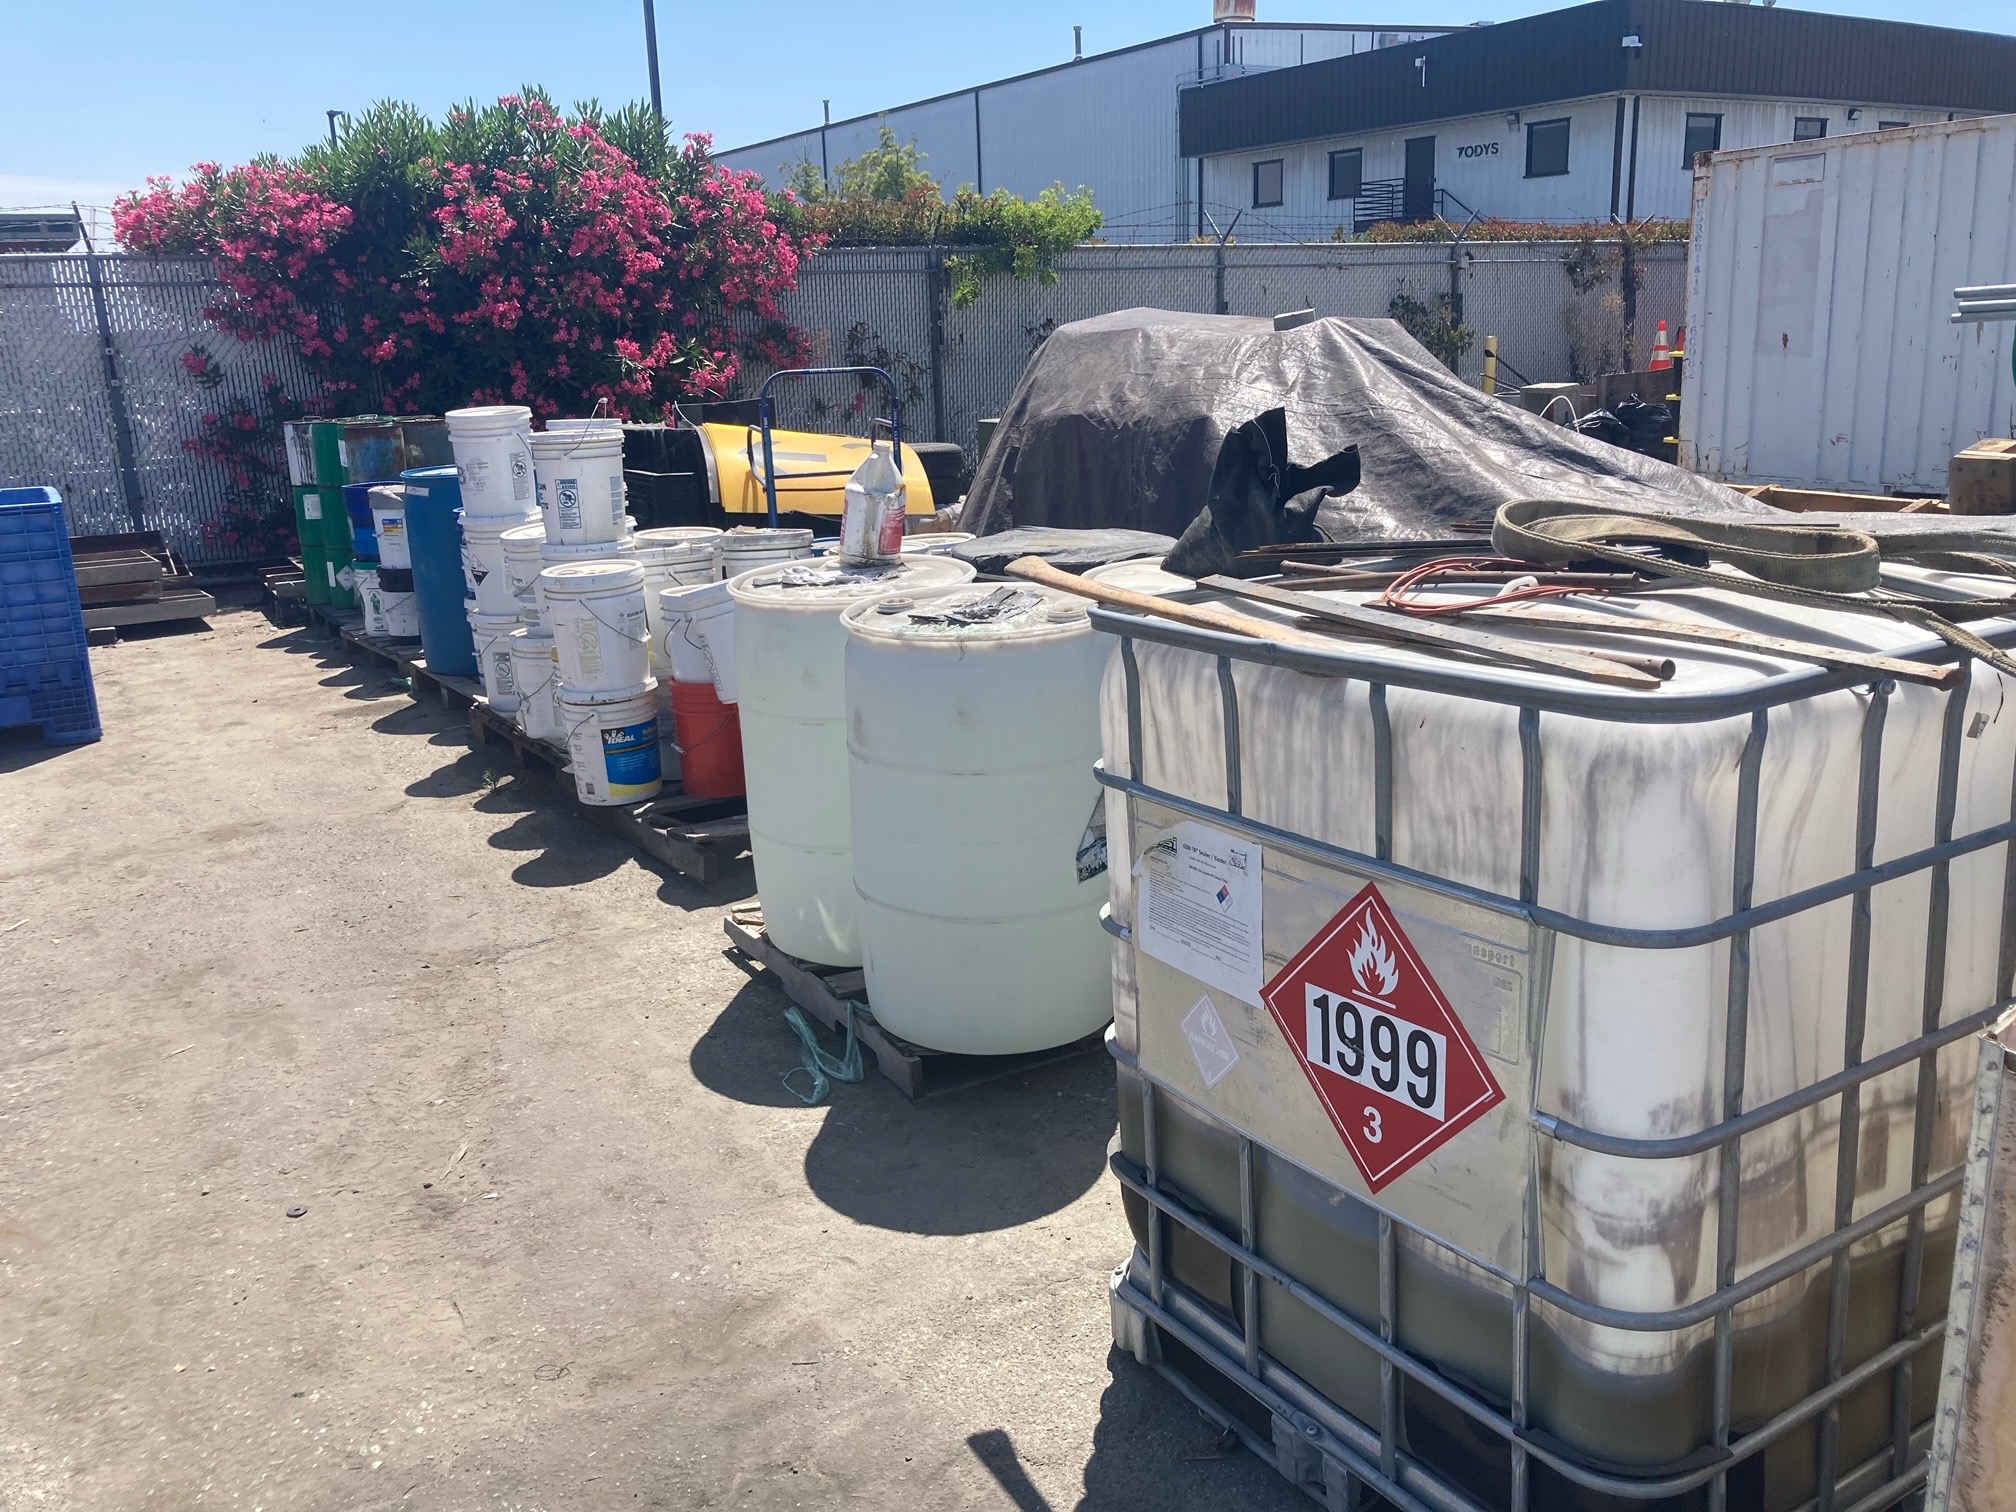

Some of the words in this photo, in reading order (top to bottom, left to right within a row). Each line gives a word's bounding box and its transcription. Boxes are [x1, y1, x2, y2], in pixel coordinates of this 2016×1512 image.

[607, 734, 636, 745] IDEAL
[1313, 993, 1437, 1109] 1999
[1363, 1105, 1383, 1144] 3
